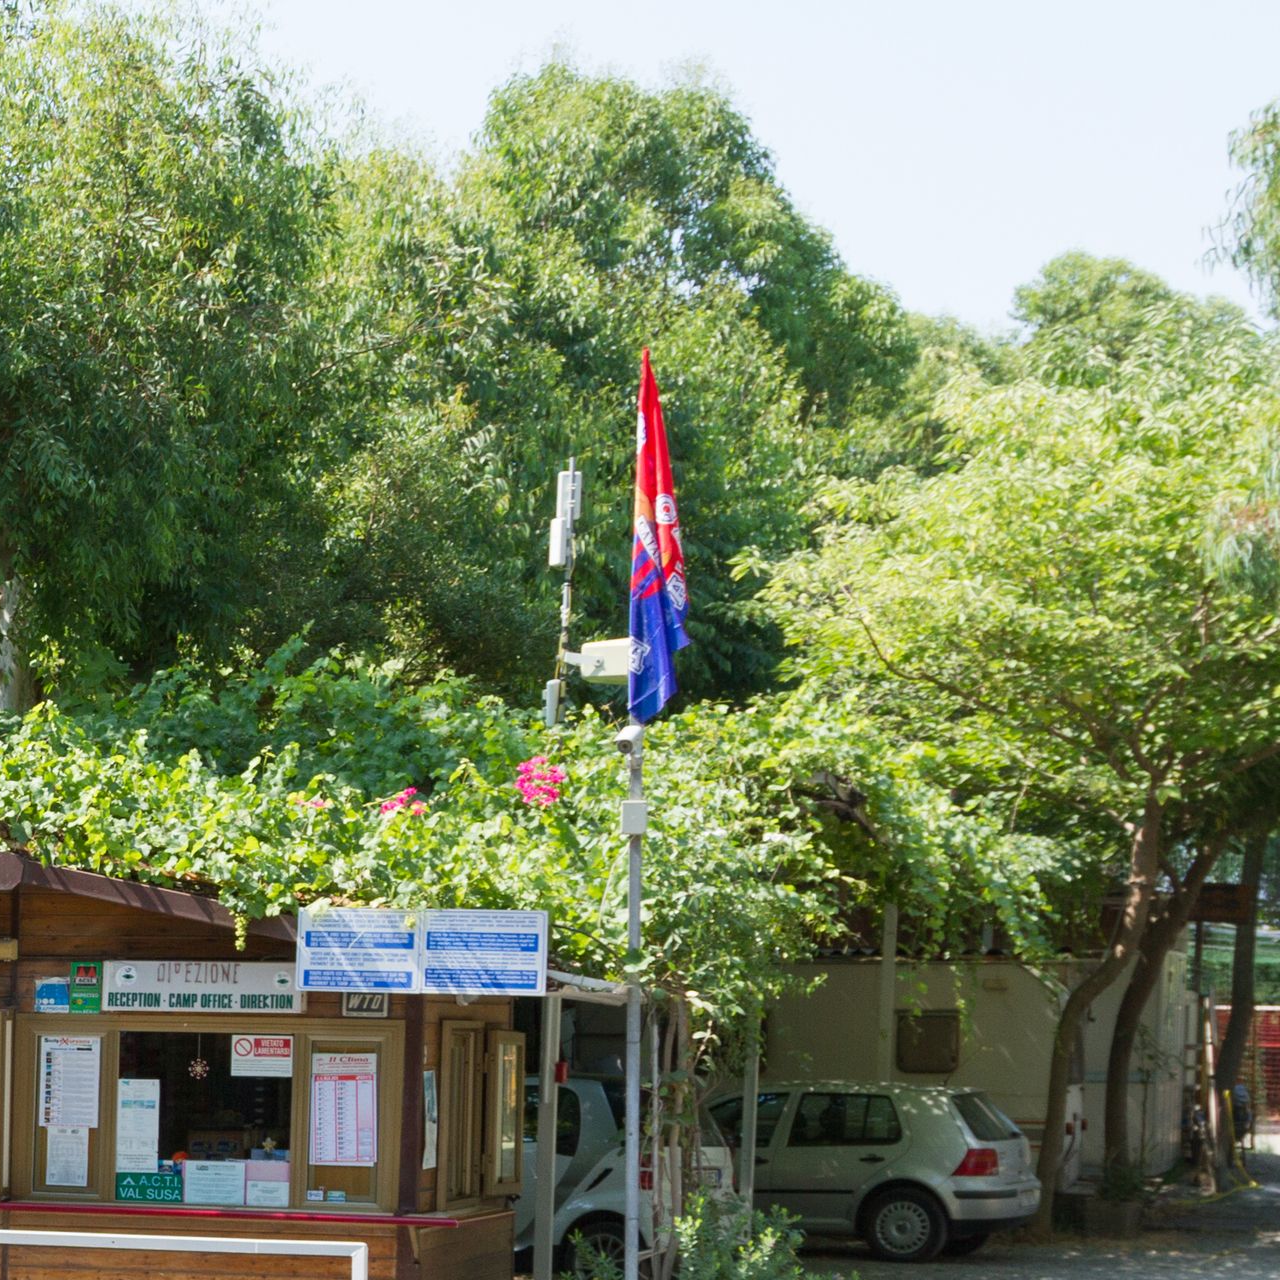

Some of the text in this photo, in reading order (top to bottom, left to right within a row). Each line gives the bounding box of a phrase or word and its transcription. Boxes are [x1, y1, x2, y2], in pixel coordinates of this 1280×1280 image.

[108, 992, 293, 1009] RECEPTION CAMP OFFICE DIREKTION
[260, 1039, 285, 1047] VIETATO
[119, 1188, 181, 1200] VAL SUSA
